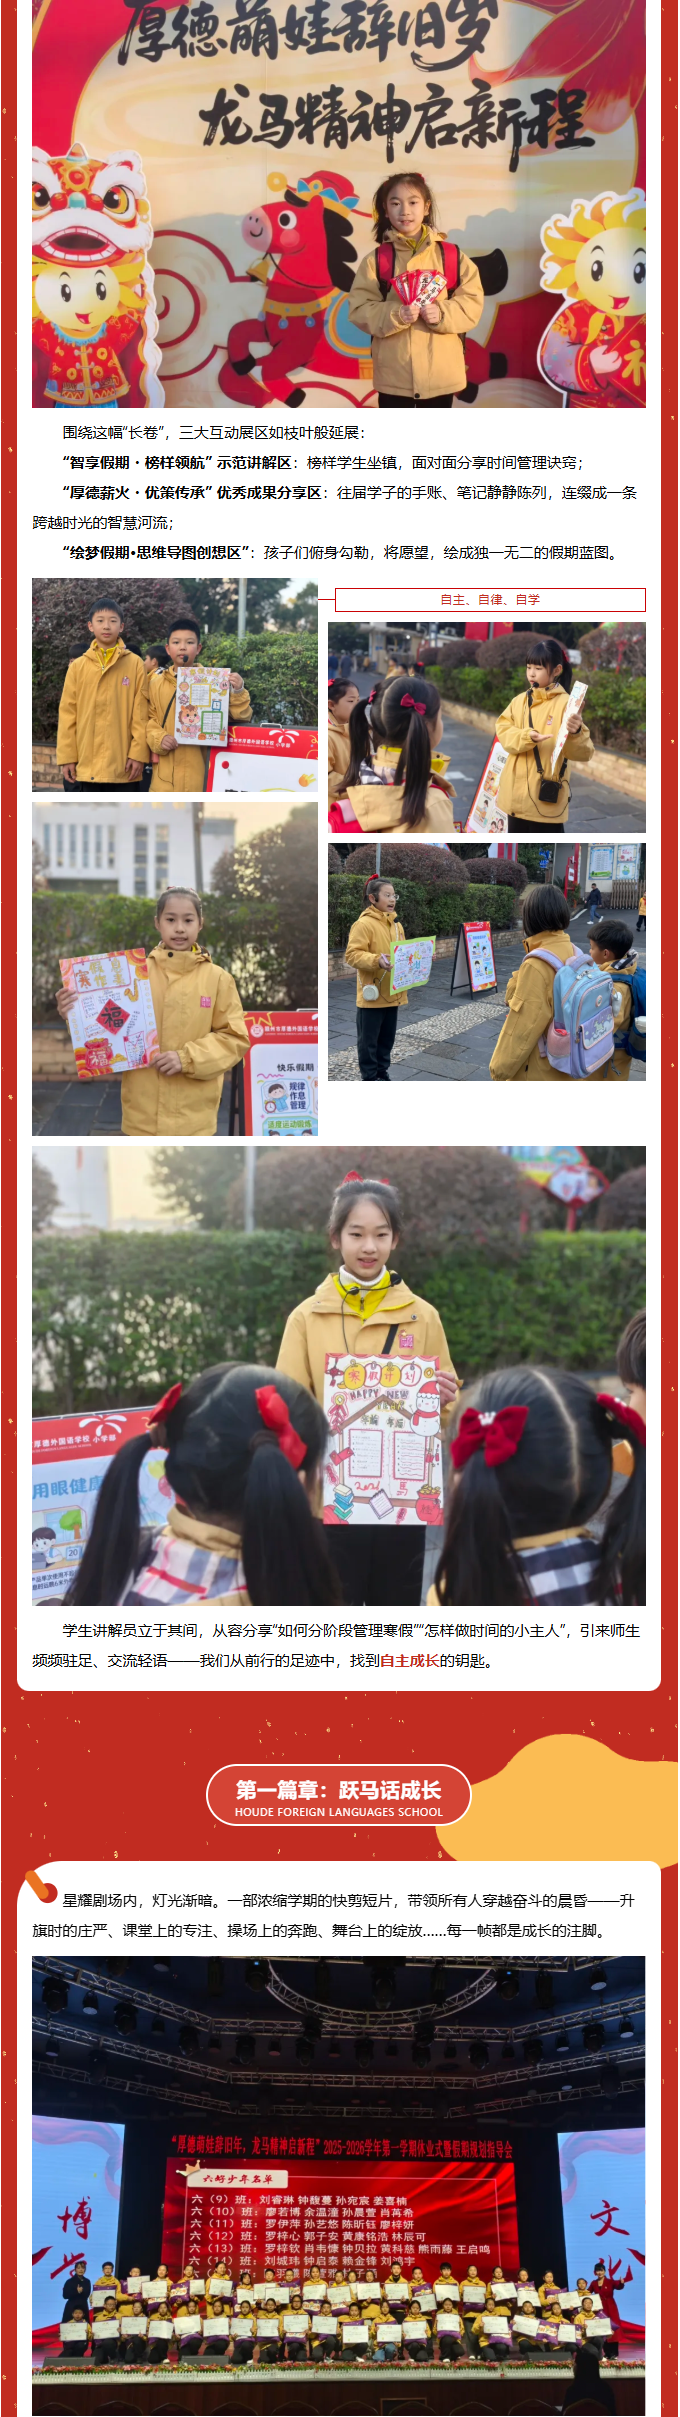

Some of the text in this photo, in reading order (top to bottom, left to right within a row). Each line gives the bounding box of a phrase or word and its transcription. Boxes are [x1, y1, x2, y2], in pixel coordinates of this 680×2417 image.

[117, 0, 498, 72] 厚德萌娃辞旧岁
[200, 78, 596, 173] 龙马精神启新程
[101, 1006, 124, 1028] 福
[277, 1063, 314, 1072] 快乐假期
[289, 1082, 305, 1091] 规律
[290, 1091, 306, 1100] 作息
[290, 1101, 307, 1110] 管理
[350, 1388, 409, 1401] HAPPY NEW
[33, 1434, 117, 1448] 厚德外国语学校 小学部
[68, 1549, 78, 1557] 20
